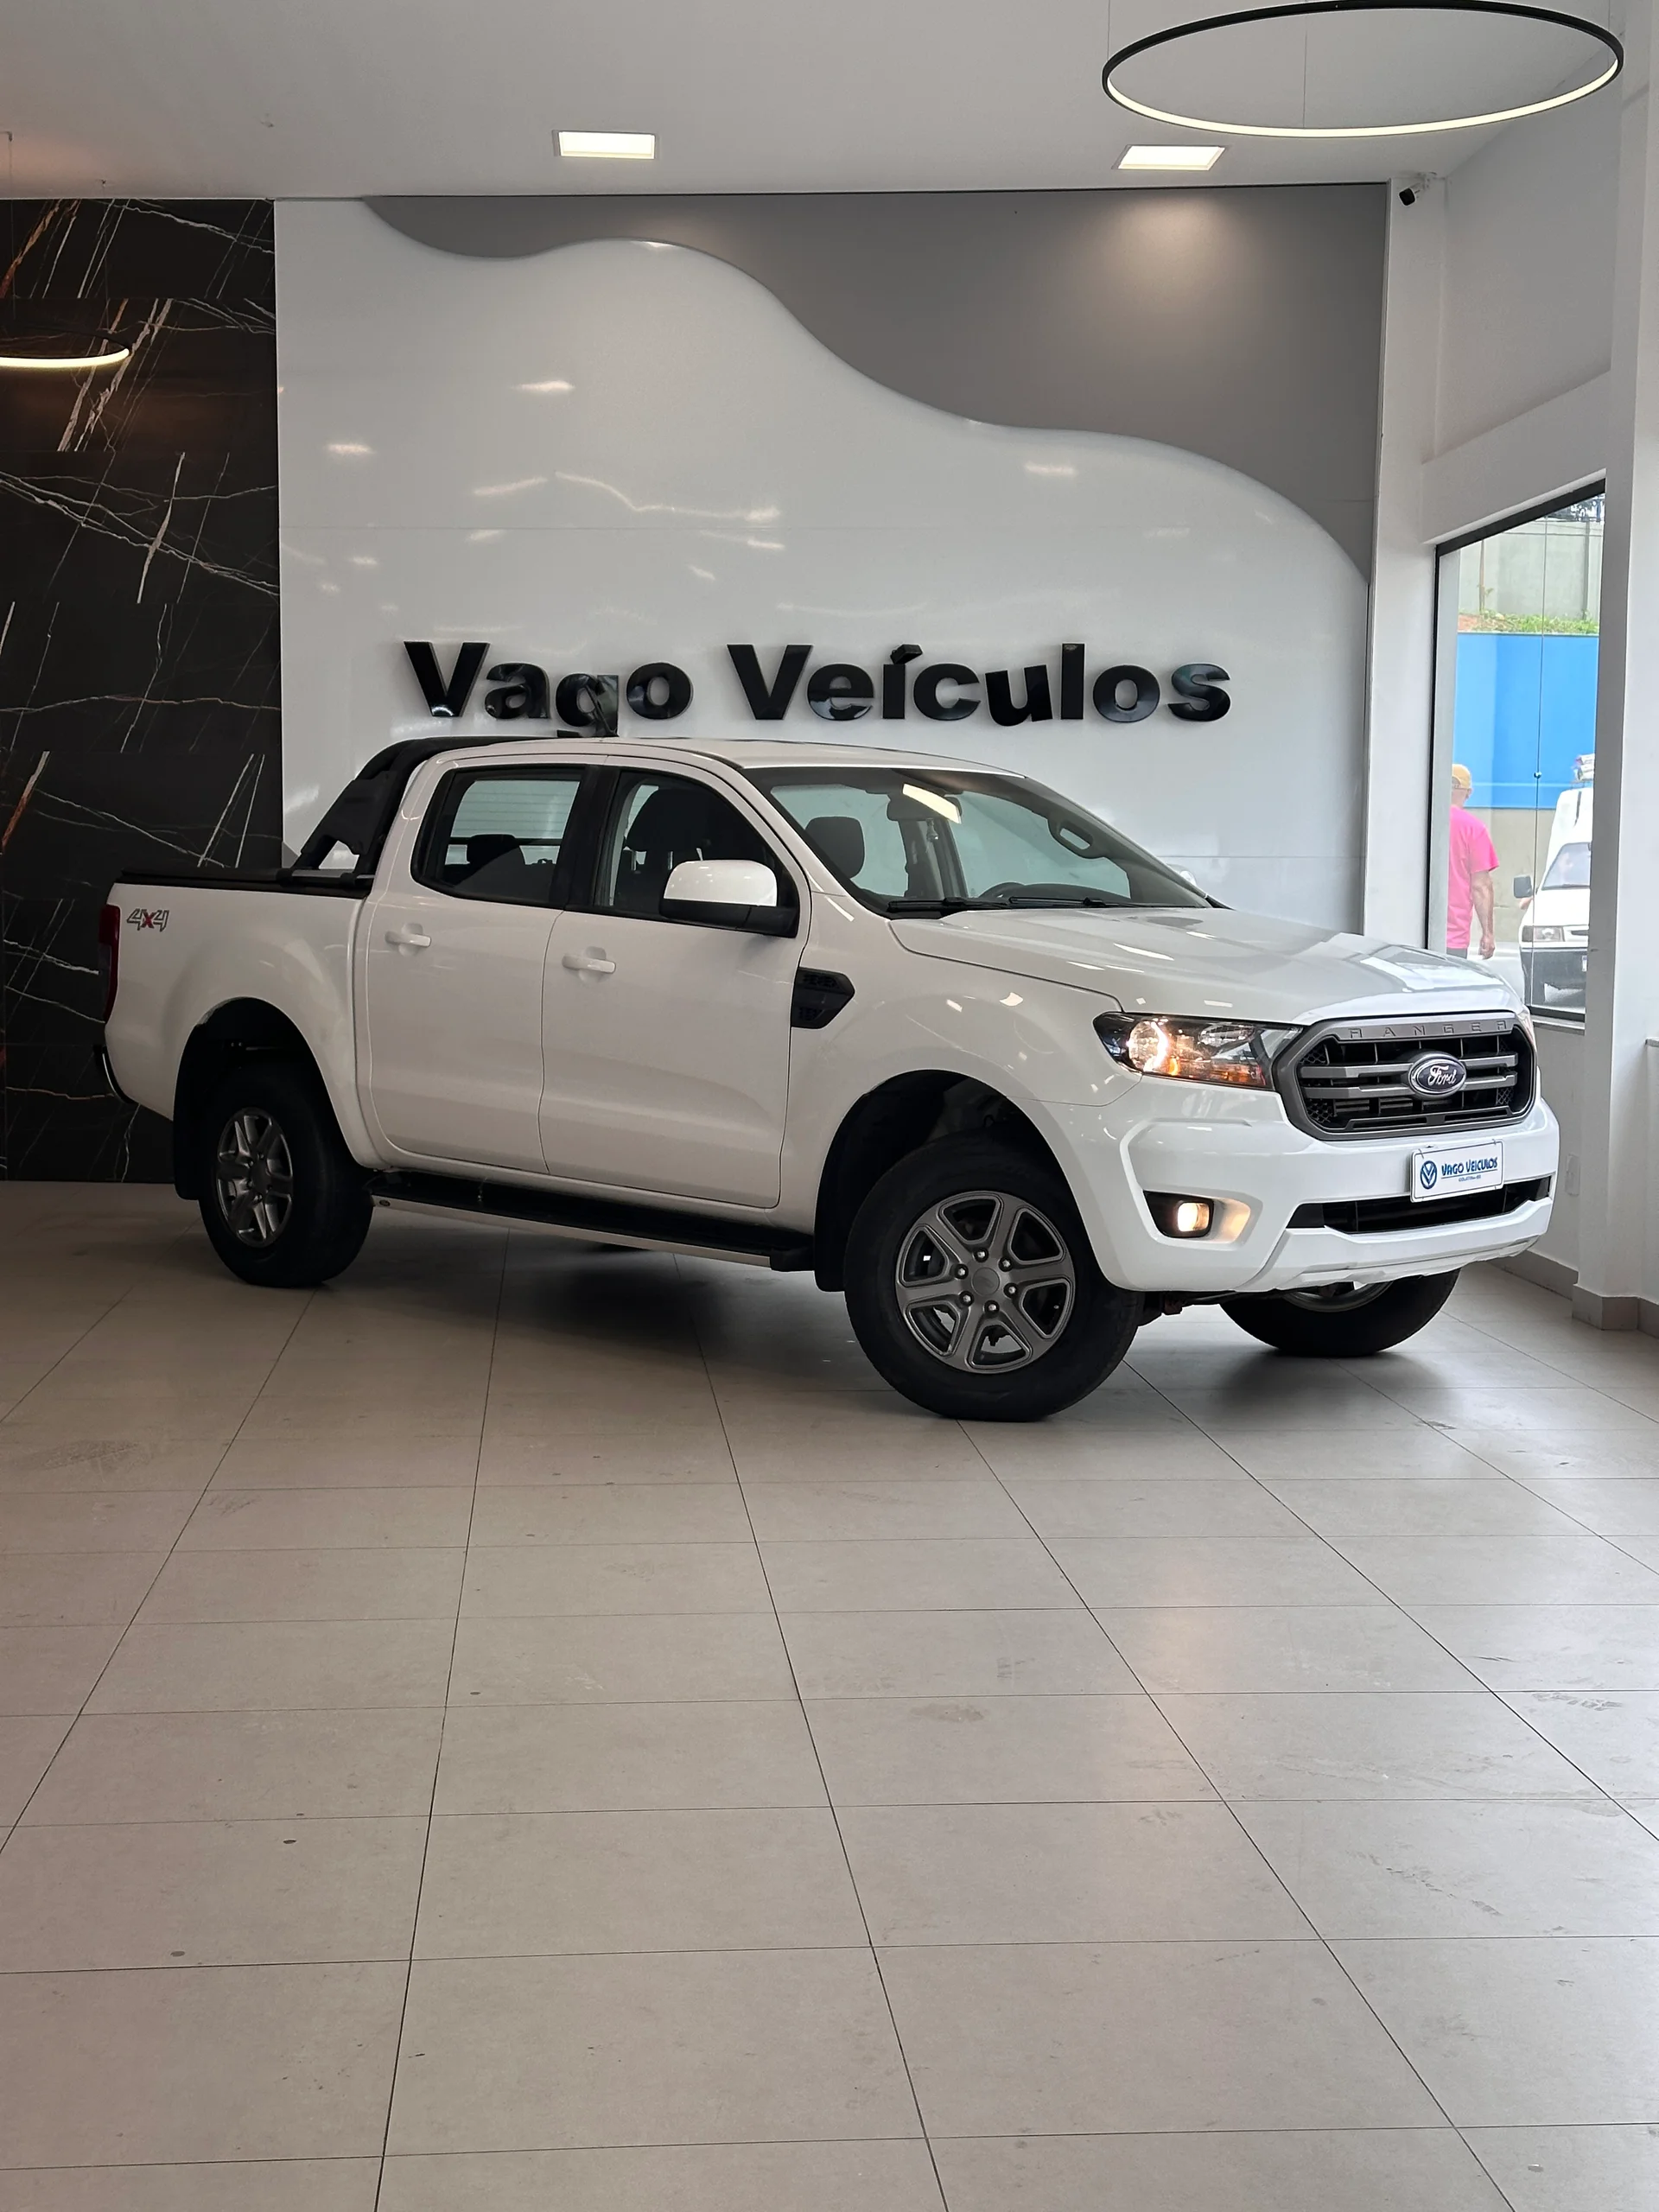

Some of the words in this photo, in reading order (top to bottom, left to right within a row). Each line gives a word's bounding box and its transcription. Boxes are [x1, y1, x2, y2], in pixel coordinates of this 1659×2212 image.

[404, 640, 693, 738] Vago
[727, 643, 1231, 727] Veículos
[1349, 1020, 1507, 1039] RANGER
[1427, 1065, 1457, 1085] Ford
[1441, 1163, 1464, 1176] VAGO
